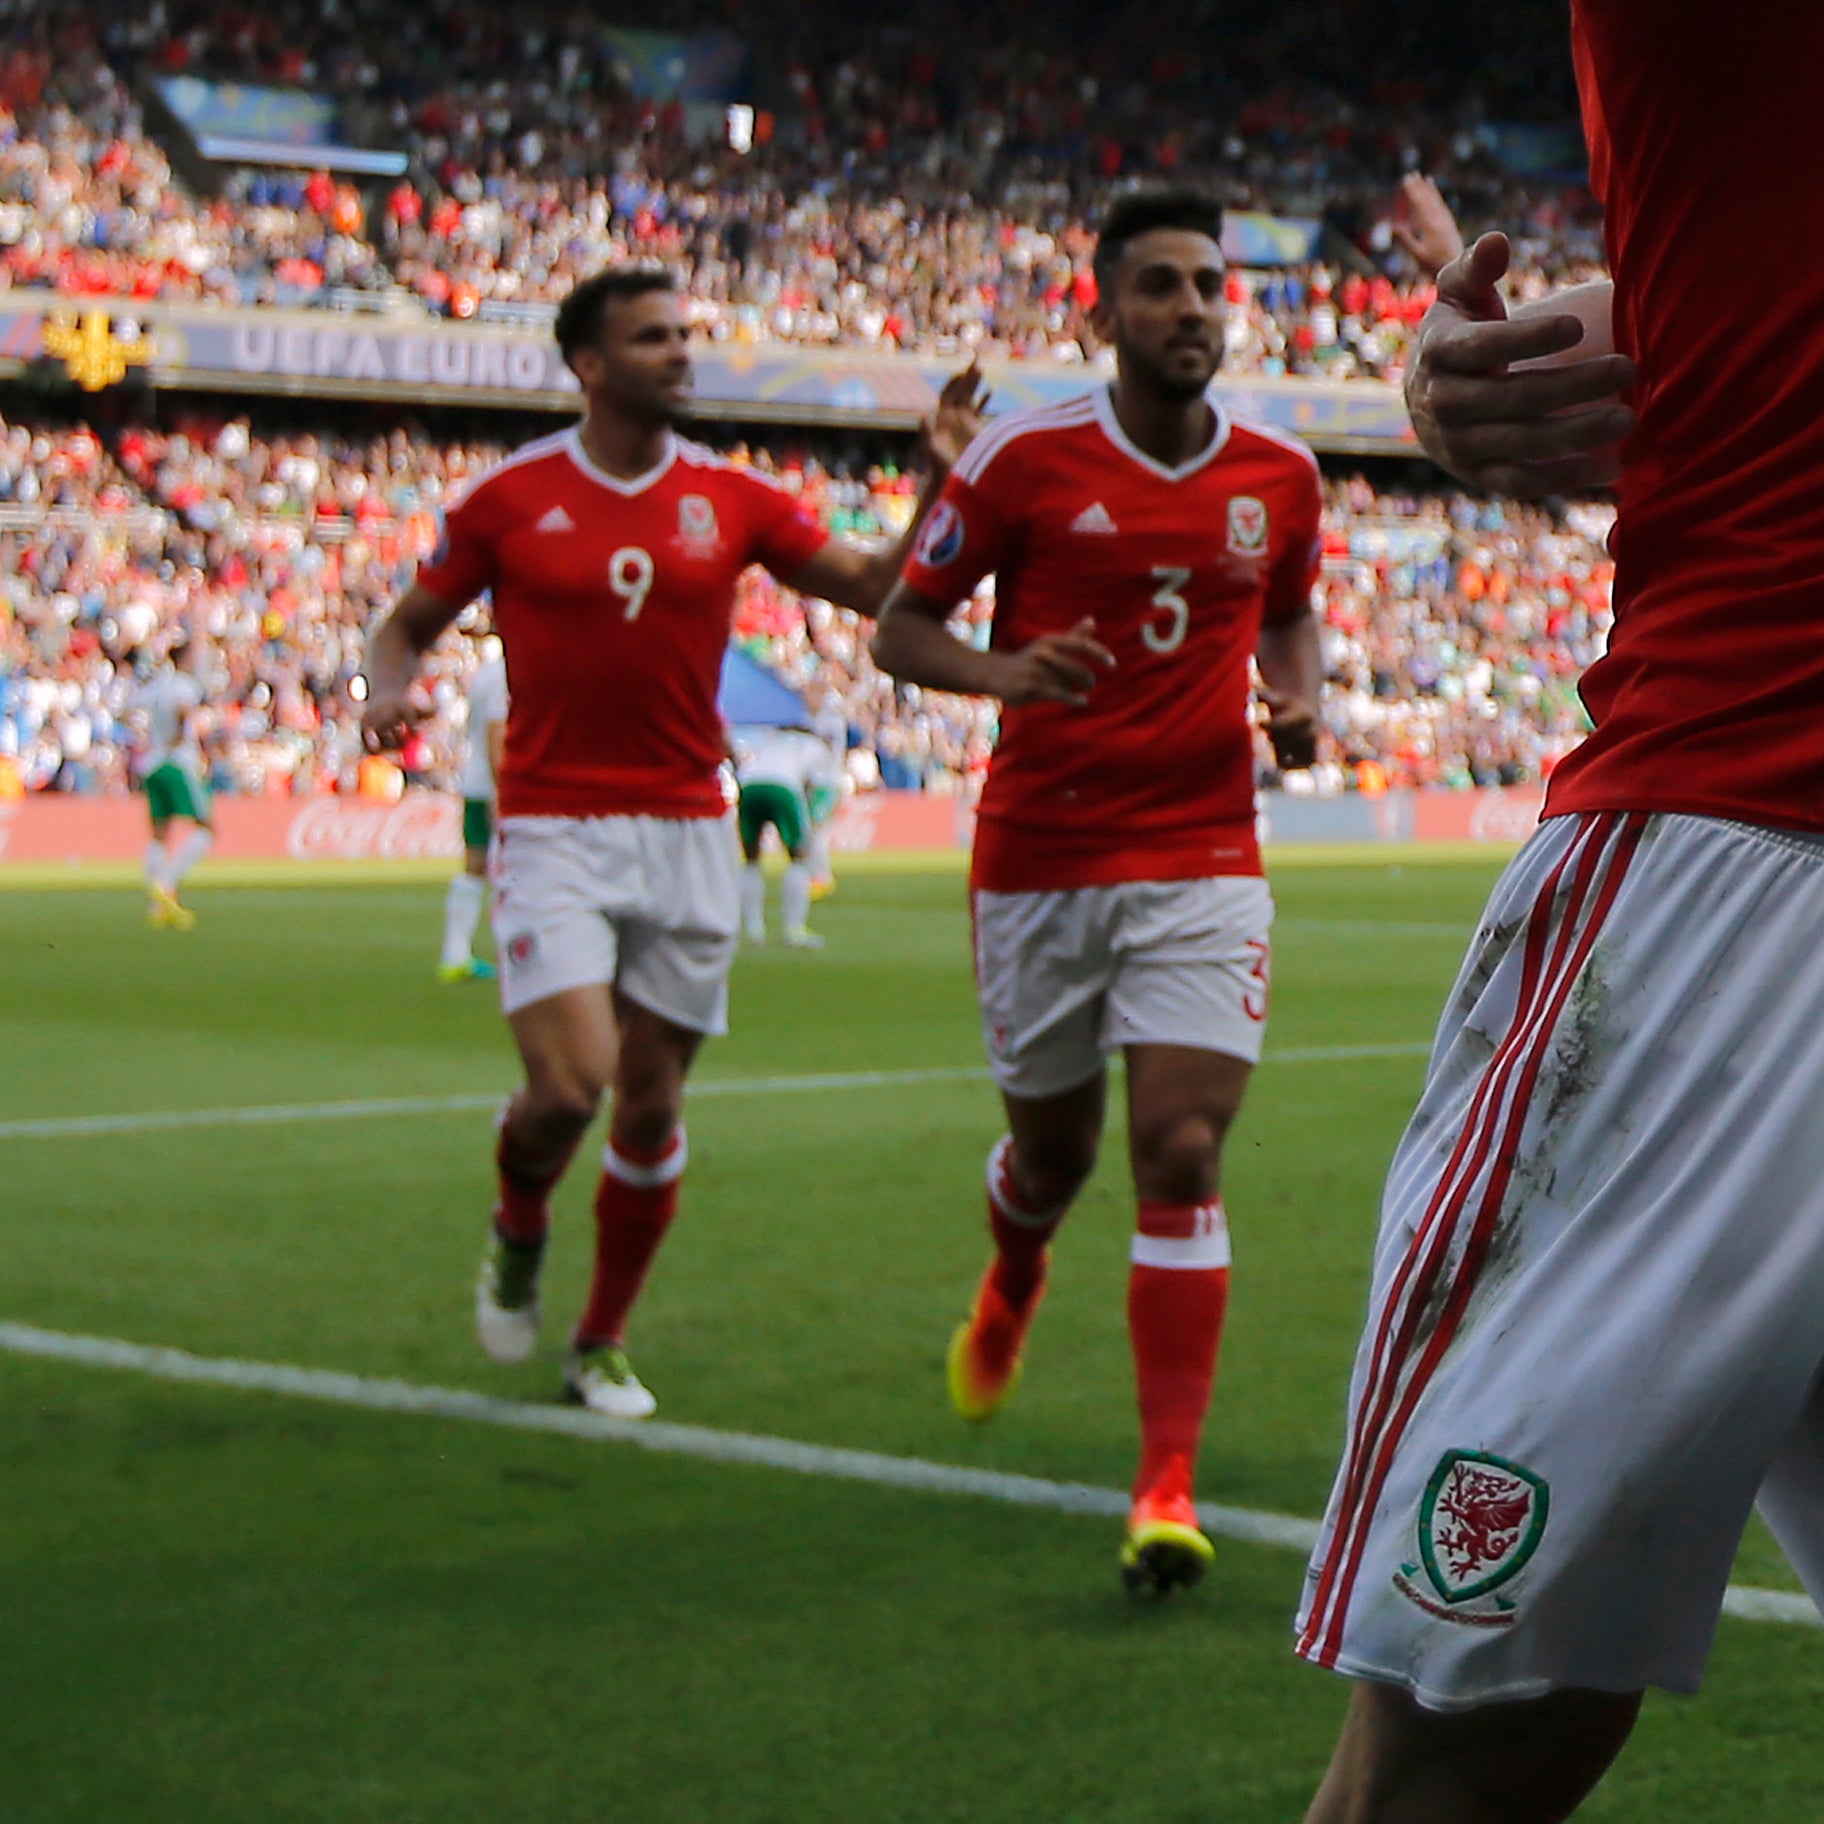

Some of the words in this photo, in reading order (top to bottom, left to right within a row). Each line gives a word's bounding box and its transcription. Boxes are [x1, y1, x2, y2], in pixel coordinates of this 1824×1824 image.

[229, 324, 387, 382] UEFA
[394, 334, 547, 390] EURO
[609, 547, 655, 622] 9
[1141, 566, 1193, 654] 3
[1242, 938, 1270, 1024] 3
